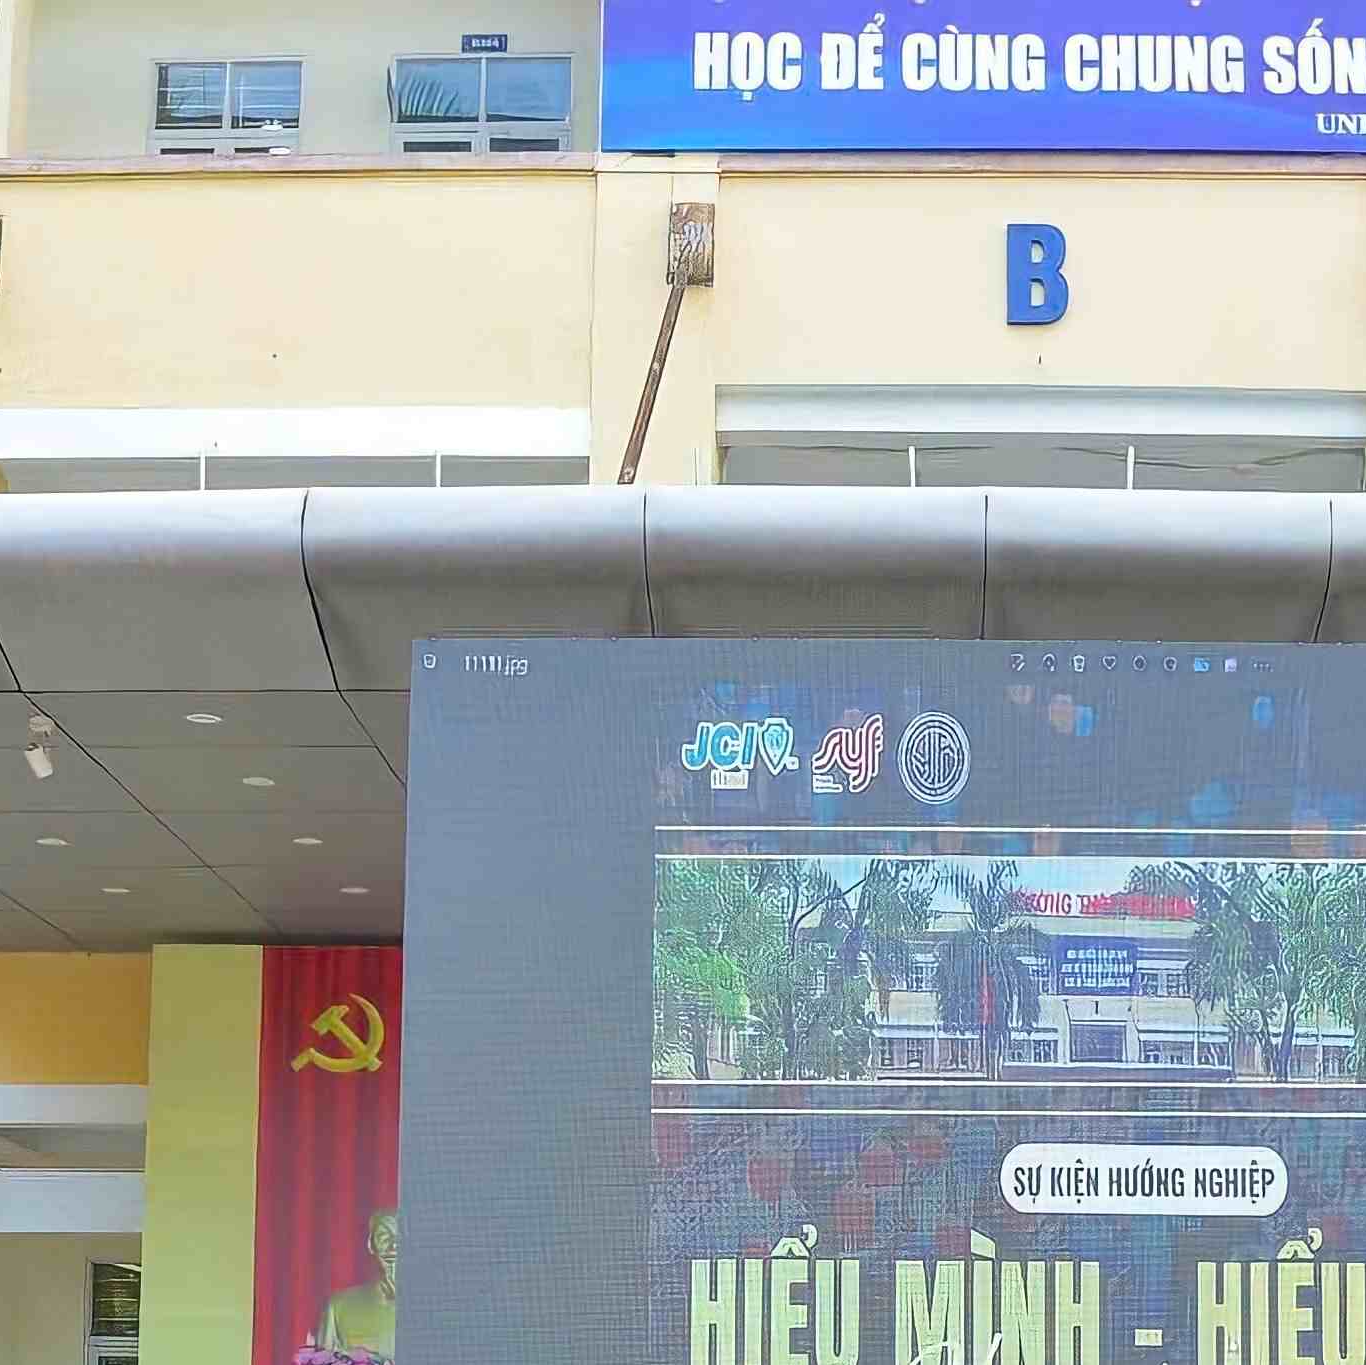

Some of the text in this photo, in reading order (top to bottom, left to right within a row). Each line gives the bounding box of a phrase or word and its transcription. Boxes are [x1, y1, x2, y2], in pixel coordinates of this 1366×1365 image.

[693, 31, 803, 101] HỌC
[821, 14, 885, 91] ĐỂ
[901, 25, 1046, 92] CÙNG
[1065, 34, 1244, 94] CHUNG
[1007, 224, 1069, 325] B
[682, 722, 758, 770] JCI
[1014, 1158, 1275, 1204] SỰ KIỆN HƯỚNG NGHIỆP
